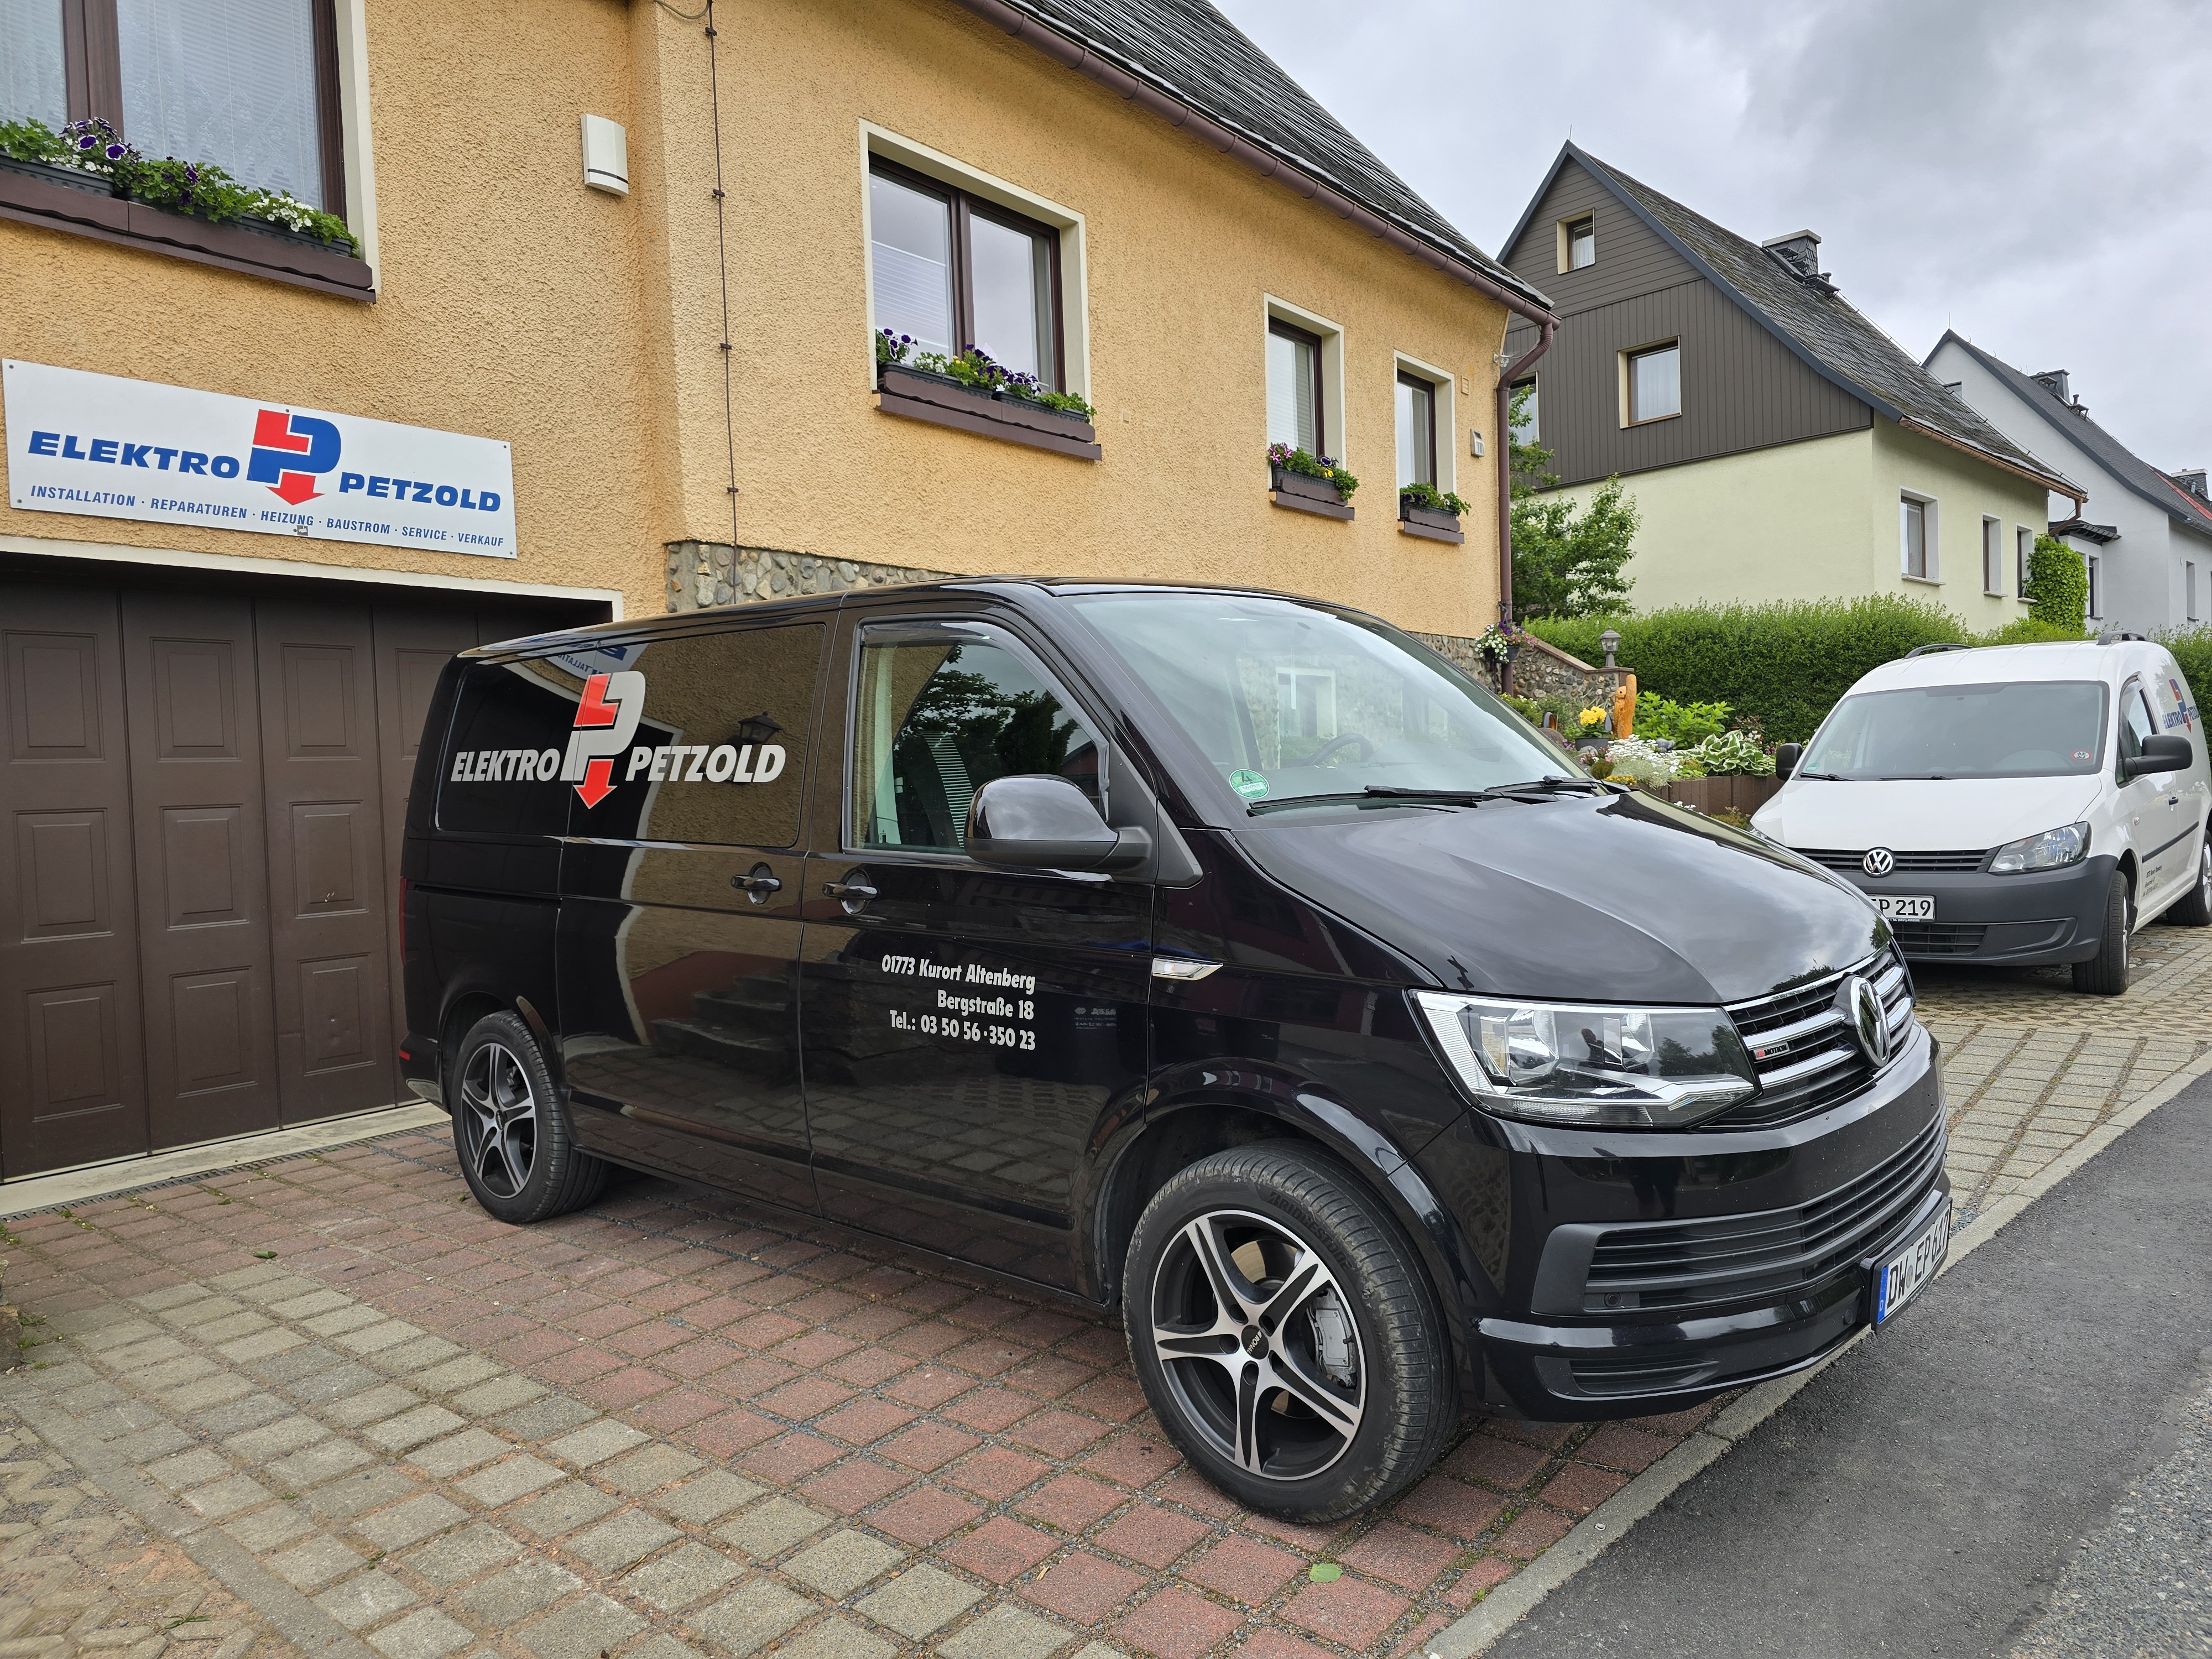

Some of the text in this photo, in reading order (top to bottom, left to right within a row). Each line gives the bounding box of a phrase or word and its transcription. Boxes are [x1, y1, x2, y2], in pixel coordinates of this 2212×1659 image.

[28, 430, 240, 479] ELEKTRO
[339, 472, 501, 512] PETZOLD
[31, 486, 504, 547] INSTALLATION REPARATUREN HEIZUNG BAUSTROM SERVICE VERKAUF
[450, 749, 560, 781] ELEKTRO
[625, 744, 786, 782] PETZOLD
[1240, 771, 1253, 784] 4
[1896, 899, 1931, 916] 219
[881, 954, 1036, 995] 01773 Kurort Altenberg
[937, 989, 1034, 1020] Bergstraße 18
[889, 1009, 916, 1031] Tel.:
[921, 1014, 937, 1034] 03
[942, 1018, 959, 1037] 50
[1019, 1030, 1036, 1051] 23
[1887, 1255, 1909, 1310] DW
[1247, 1334, 1260, 1354] RONAL
